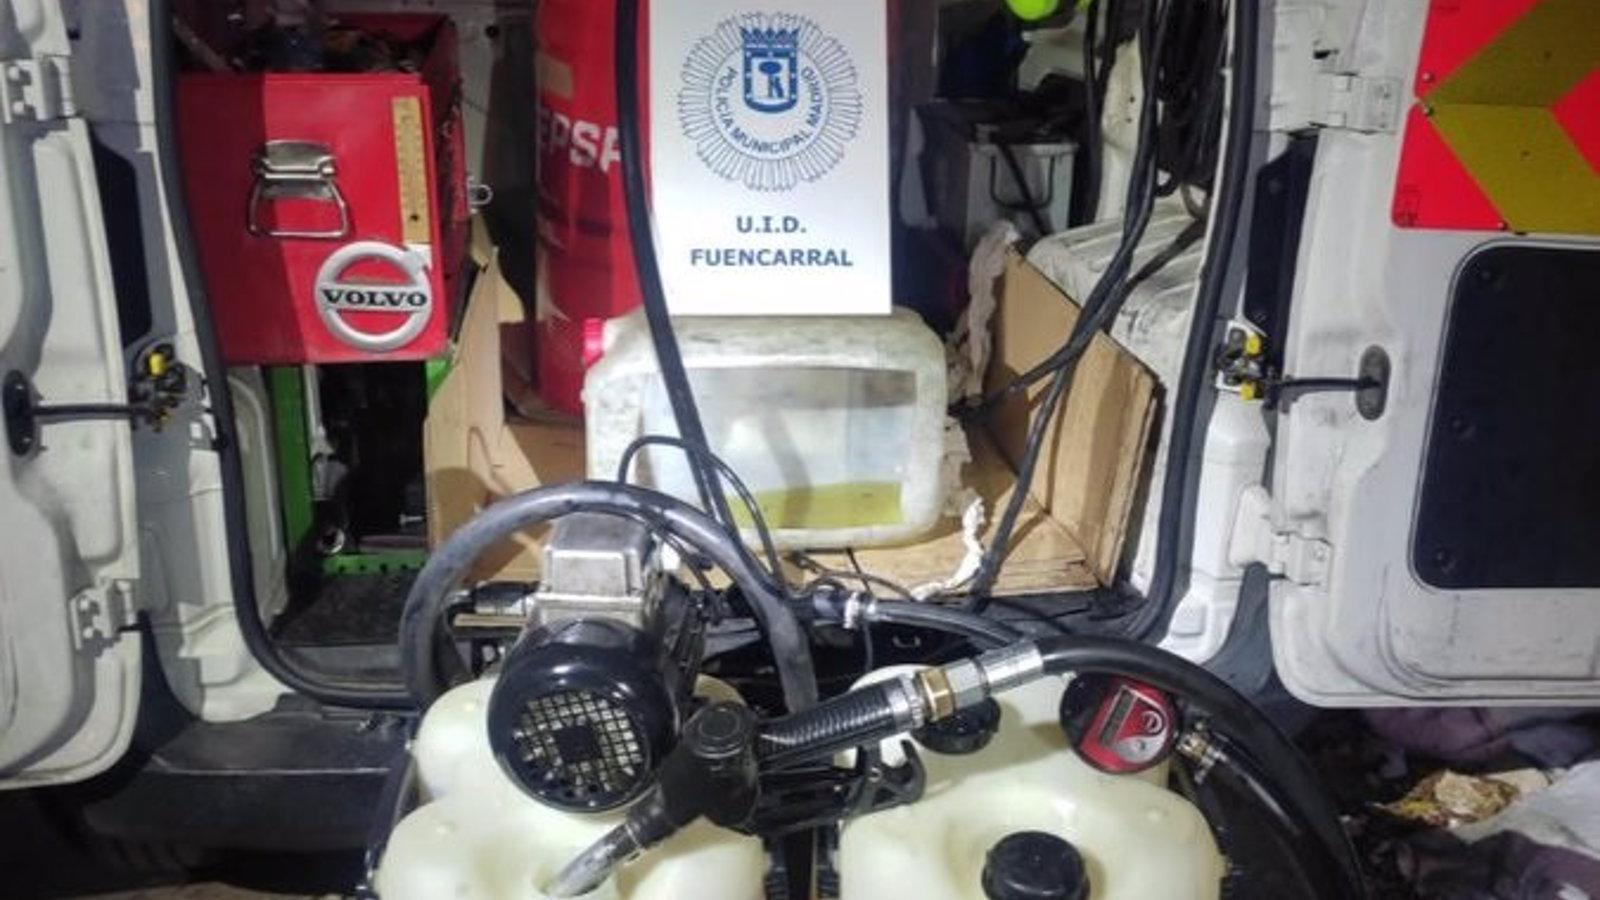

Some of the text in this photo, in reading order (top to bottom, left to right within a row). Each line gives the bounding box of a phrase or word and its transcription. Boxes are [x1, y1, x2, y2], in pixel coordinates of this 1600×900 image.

[730, 127, 813, 154] MUNICIPAL
[801, 66, 823, 127] MADRID
[736, 216, 807, 233] U.I.D.
[690, 248, 853, 266] FUENCARRAL
[321, 289, 427, 307] VOLVO
